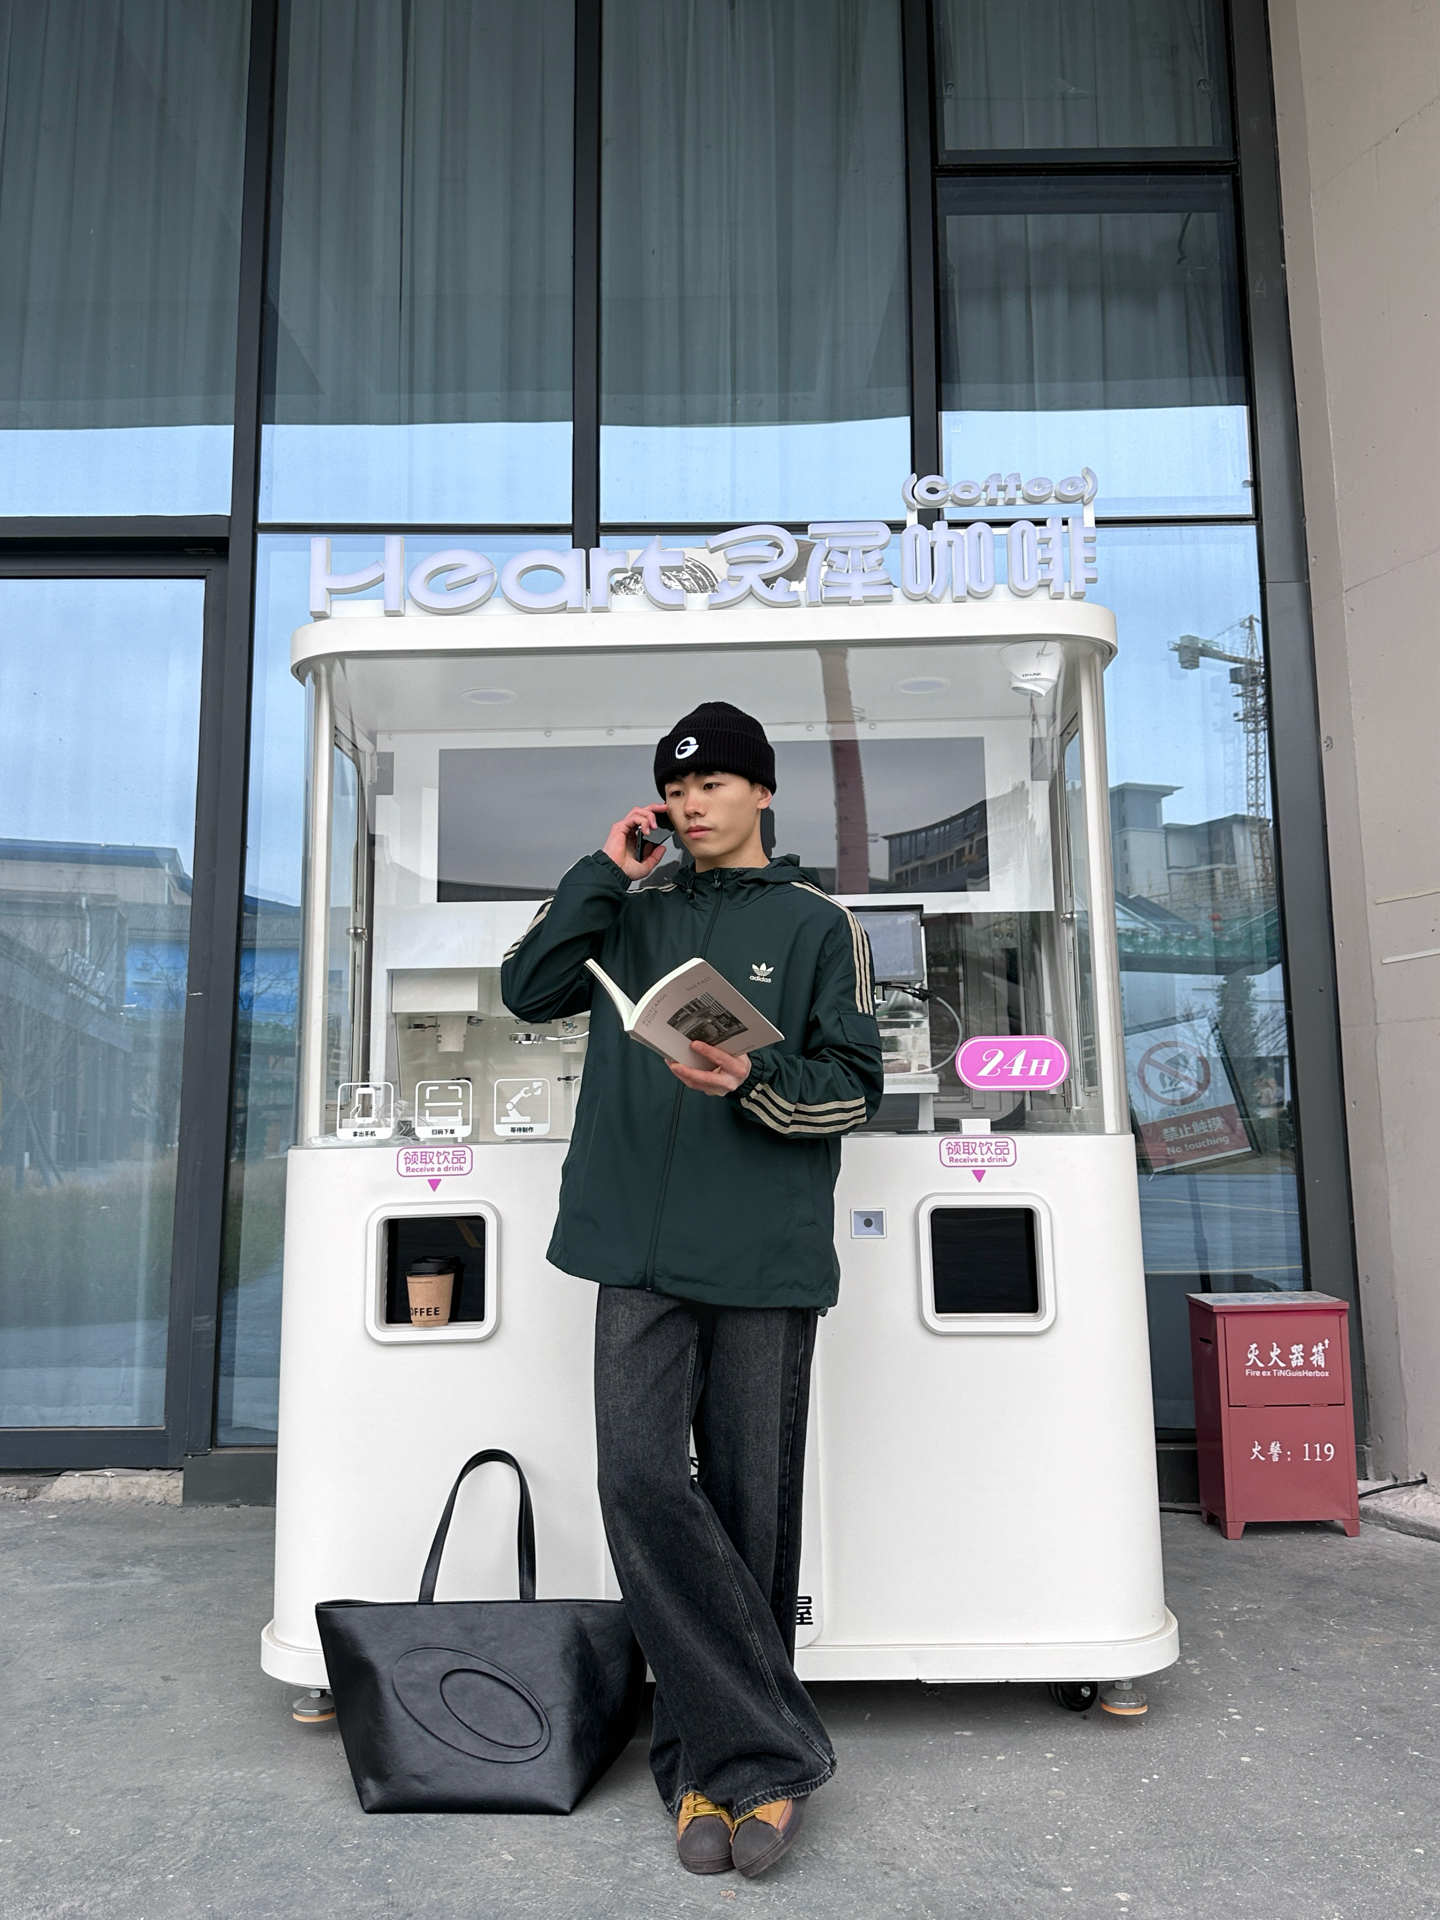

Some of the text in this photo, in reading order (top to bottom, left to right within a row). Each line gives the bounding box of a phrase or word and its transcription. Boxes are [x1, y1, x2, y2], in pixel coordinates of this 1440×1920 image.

[310, 535, 687, 617] Heart
[749, 975, 772, 983] adidas
[642, 993, 668, 1025] POSTCARDS
[645, 1010, 658, 1028] FROM
[976, 1048, 1053, 1077] 24H
[352, 1130, 377, 1138] 拿出手机
[1161, 1116, 1226, 1143] 禁止触摸
[946, 1141, 1010, 1156] 领取饮品
[1166, 1135, 1230, 1155] No touching
[403, 1150, 467, 1166] 领取饮品
[987, 1155, 1008, 1163] drink
[405, 1165, 435, 1173] Receive
[443, 1164, 464, 1172] drink
[1245, 1342, 1326, 1369] 灭火器箱
[1245, 1368, 1261, 1377] Fire
